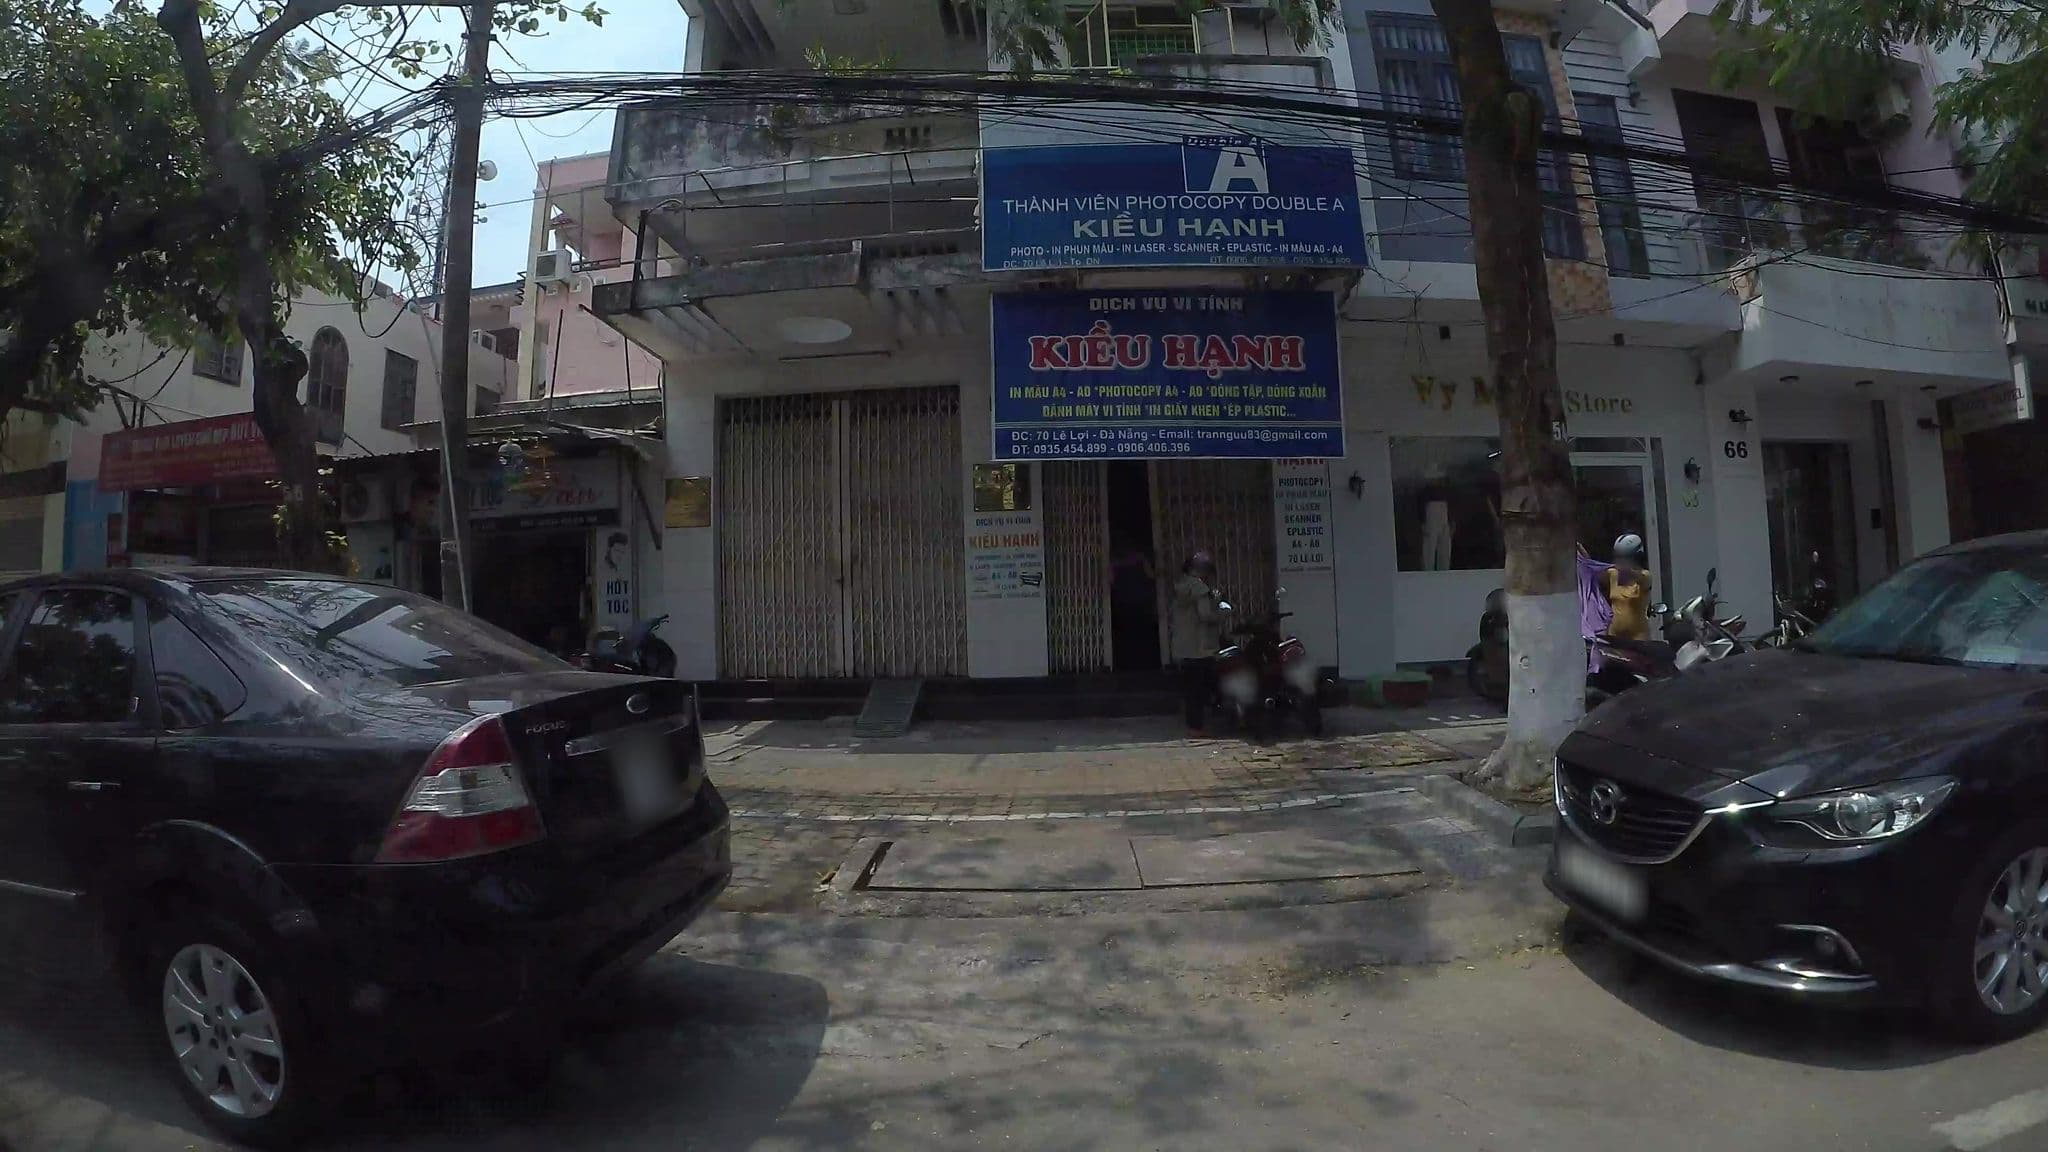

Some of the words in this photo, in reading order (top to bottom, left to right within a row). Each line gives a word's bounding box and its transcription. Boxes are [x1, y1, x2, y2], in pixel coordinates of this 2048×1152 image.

[1209, 147, 1268, 193] A
[1003, 196, 1069, 214] THÀNH
[1074, 193, 1120, 211] VIÊN
[1126, 195, 1247, 210] PHOTOCOPY
[1252, 196, 1328, 211] DOUBLE
[1333, 197, 1345, 212] A
[1073, 211, 1164, 238] KIỀU
[1177, 217, 1286, 240] HẠNH
[1010, 246, 1044, 257] PHOTO
[1051, 246, 1061, 255] IN
[1063, 245, 1090, 255] PHUN
[1093, 242, 1114, 254] MÀU
[1122, 244, 1132, 253] IN
[1134, 243, 1165, 253] LASER
[1173, 243, 1219, 253] SCANNER
[1227, 243, 1272, 253] EPLASTIC
[1279, 244, 1289, 253] IN
[1332, 245, 1344, 254] A4
[1089, 297, 1136, 313] DỊCH
[1142, 297, 1168, 313] VỤ
[1173, 298, 1192, 311] VI
[1200, 295, 1244, 311] TÍNH
[1029, 320, 1151, 371] KIỀU
[1162, 334, 1306, 379] HẠNH
[1009, 386, 1022, 399] IN
[1052, 386, 1067, 398] A4
[1165, 385, 1179, 397] A4
[1565, 390, 1633, 413] Store
[1075, 403, 1101, 416] MÁY
[1102, 405, 1113, 416] VI
[1116, 403, 1142, 416] TÍNH
[1191, 405, 1220, 417] KHEN
[1011, 431, 1033, 441] ĐC:
[1036, 431, 1049, 441] 70
[1052, 431, 1067, 441] Lê
[1070, 430, 1089, 442] Lợi
[1100, 429, 1115, 440] Đà
[1118, 428, 1148, 441] Nẵng
[1158, 429, 1194, 440] Email:
[1197, 429, 1328, 442] trannguu83@gmail.com
[1011, 445, 1031, 455] ĐT:
[1033, 443, 1107, 454] 0935.454.899
[1117, 442, 1191, 453] 0906.406.396
[1724, 440, 1748, 459] 66
[1278, 477, 1323, 487] PHOTOCOPY
[1287, 526, 1324, 536] EPLASTIC
